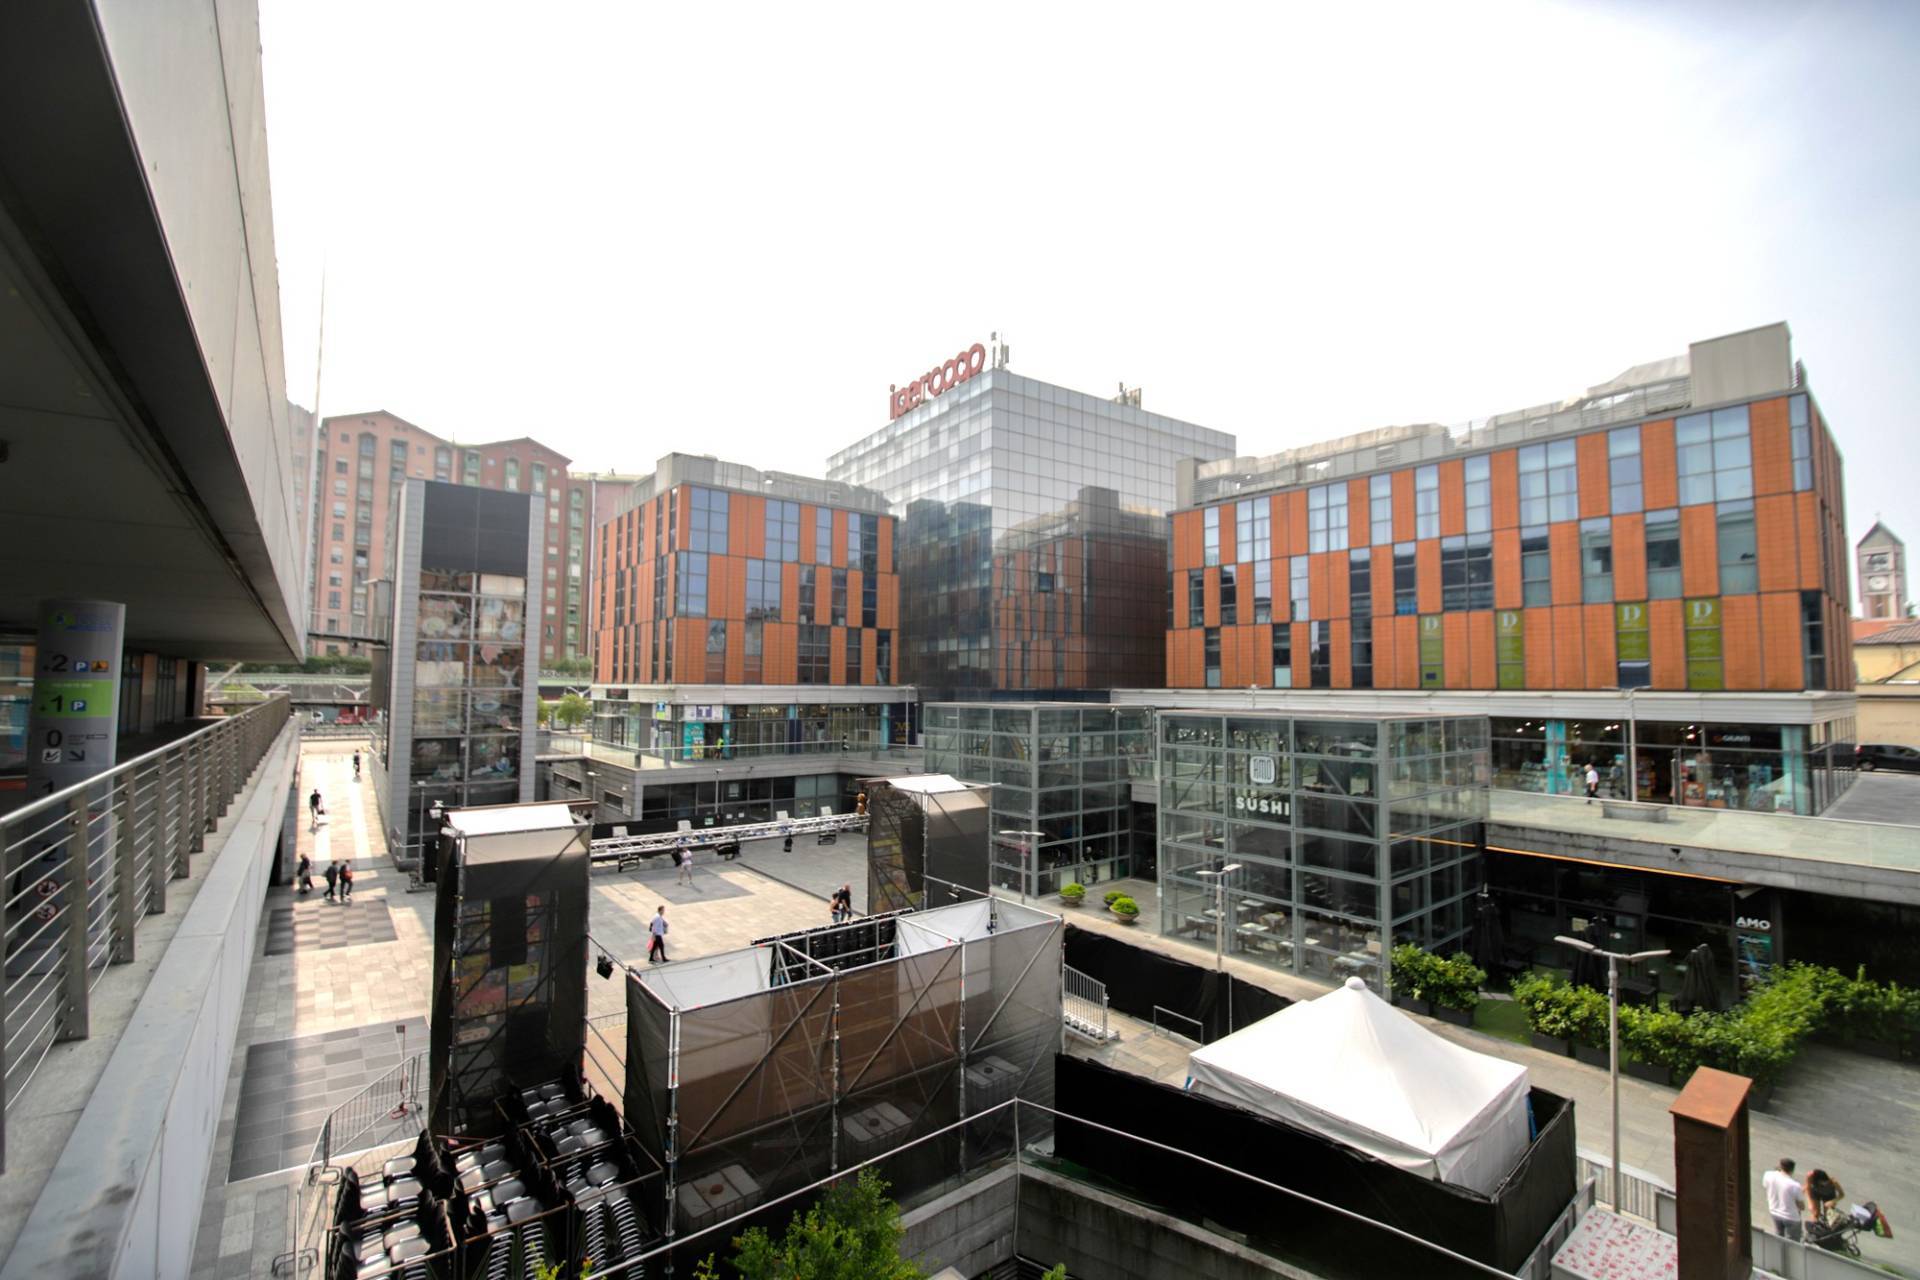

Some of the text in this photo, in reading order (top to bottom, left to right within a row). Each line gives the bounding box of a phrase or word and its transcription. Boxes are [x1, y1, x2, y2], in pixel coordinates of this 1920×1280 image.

[890, 343, 985, 420] ipercoop
[1236, 797, 1290, 816] SUSHI
[1736, 916, 1771, 930] AMO
